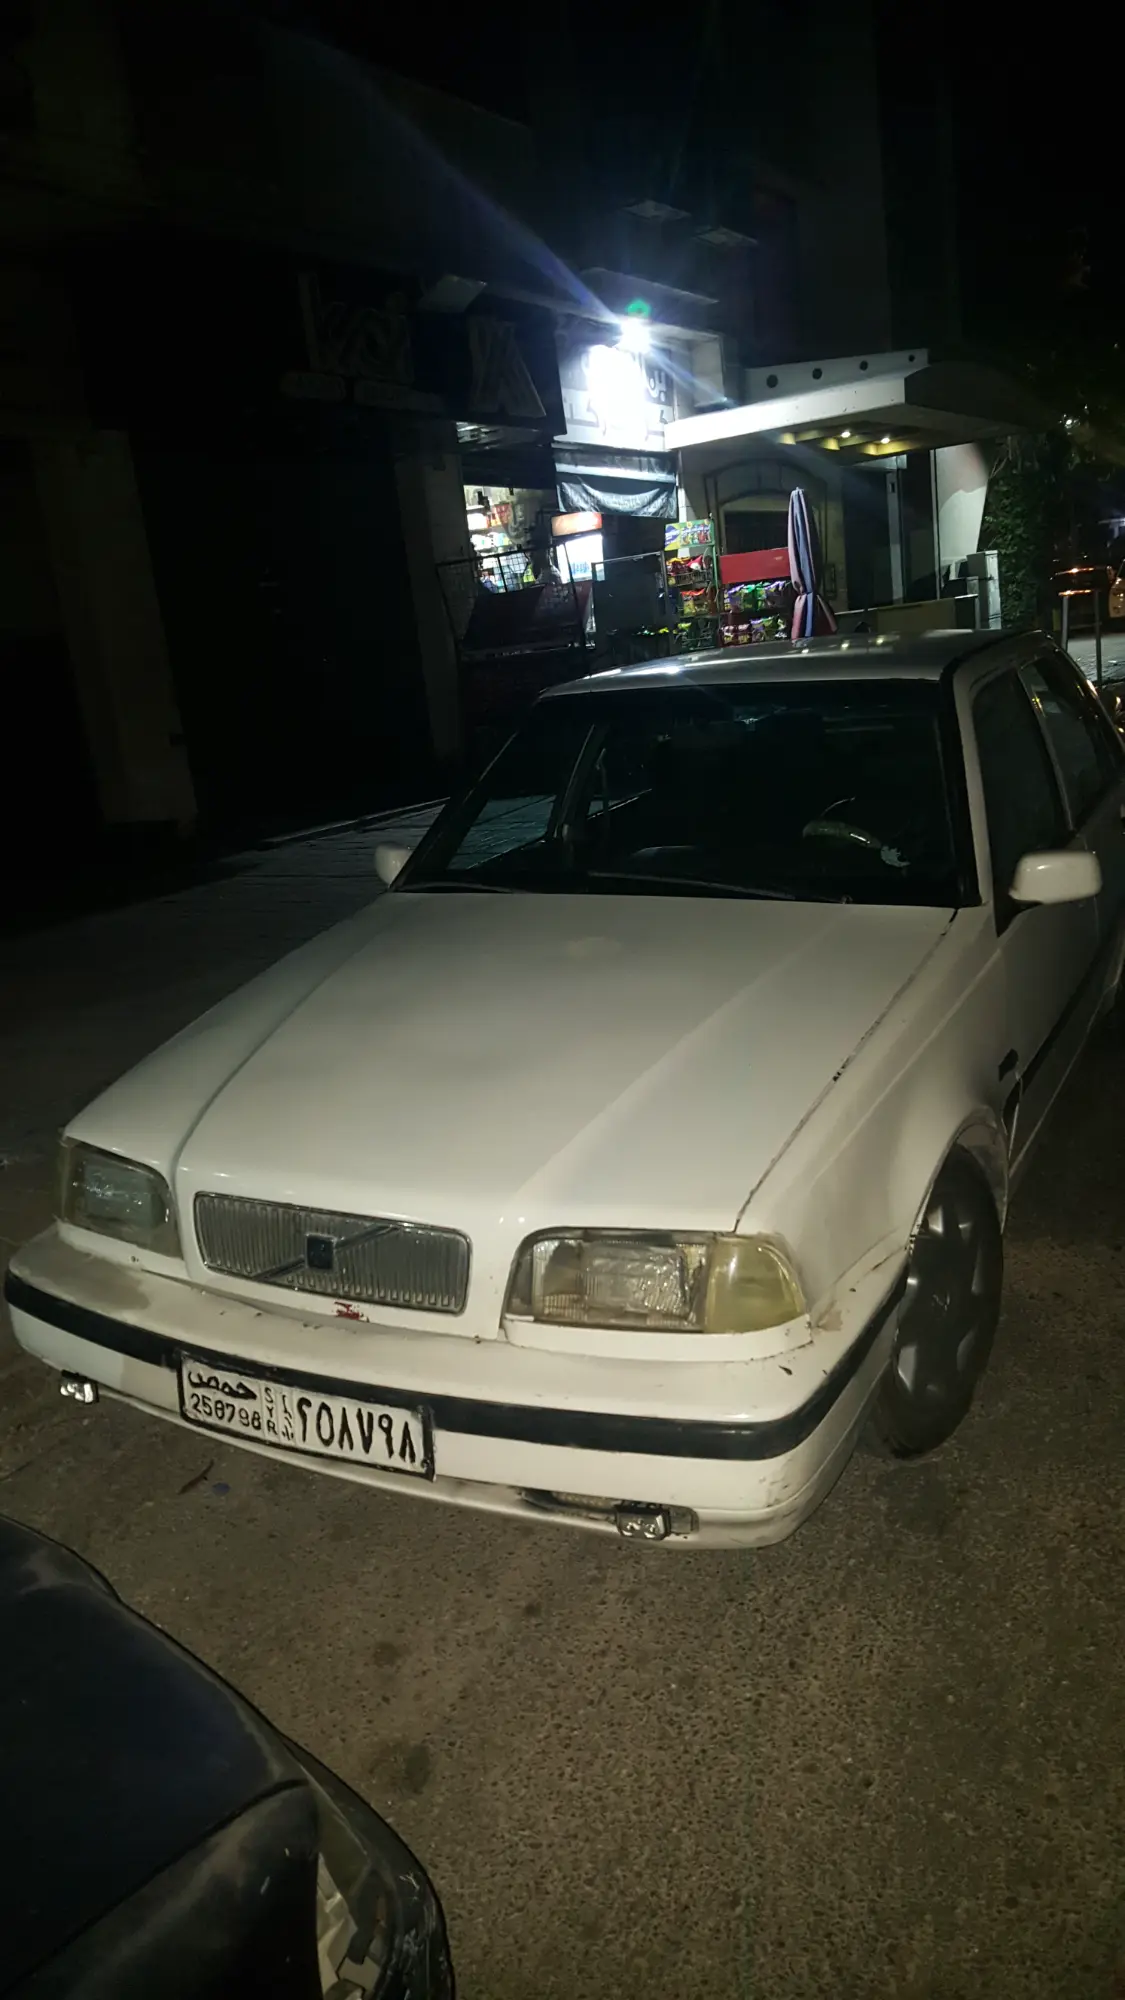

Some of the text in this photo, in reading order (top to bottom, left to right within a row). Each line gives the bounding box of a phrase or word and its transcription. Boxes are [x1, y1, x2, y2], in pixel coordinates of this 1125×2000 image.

[187, 1371, 258, 1400] حمص
[191, 1393, 261, 1430] 258798
[297, 1397, 416, 1463] ٢٥٨٧٩٨
